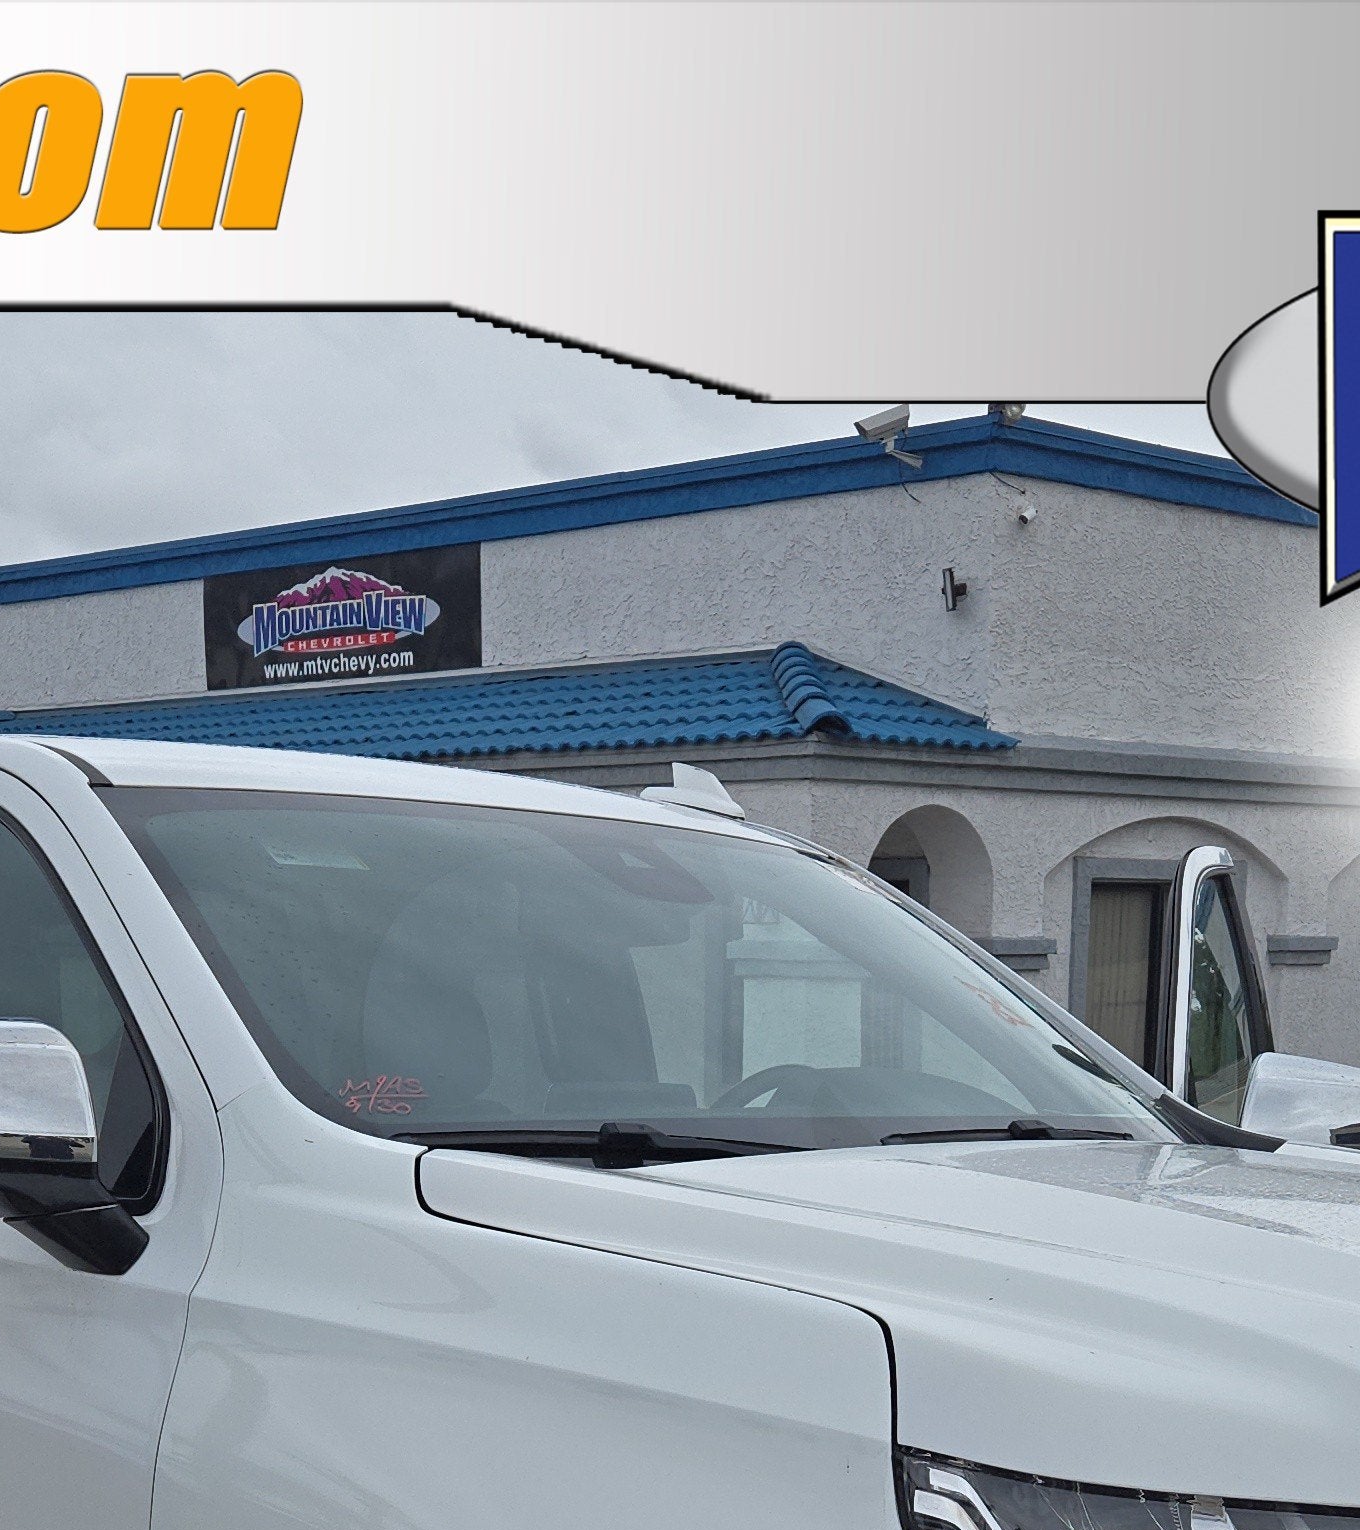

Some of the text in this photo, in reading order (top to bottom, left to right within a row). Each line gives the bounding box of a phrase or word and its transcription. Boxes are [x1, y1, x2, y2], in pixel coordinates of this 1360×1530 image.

[253, 590, 426, 657] MOUNTAIN VIEW
[287, 632, 390, 651] CHEVROLET
[264, 651, 414, 679] www.mtvchevy.com
